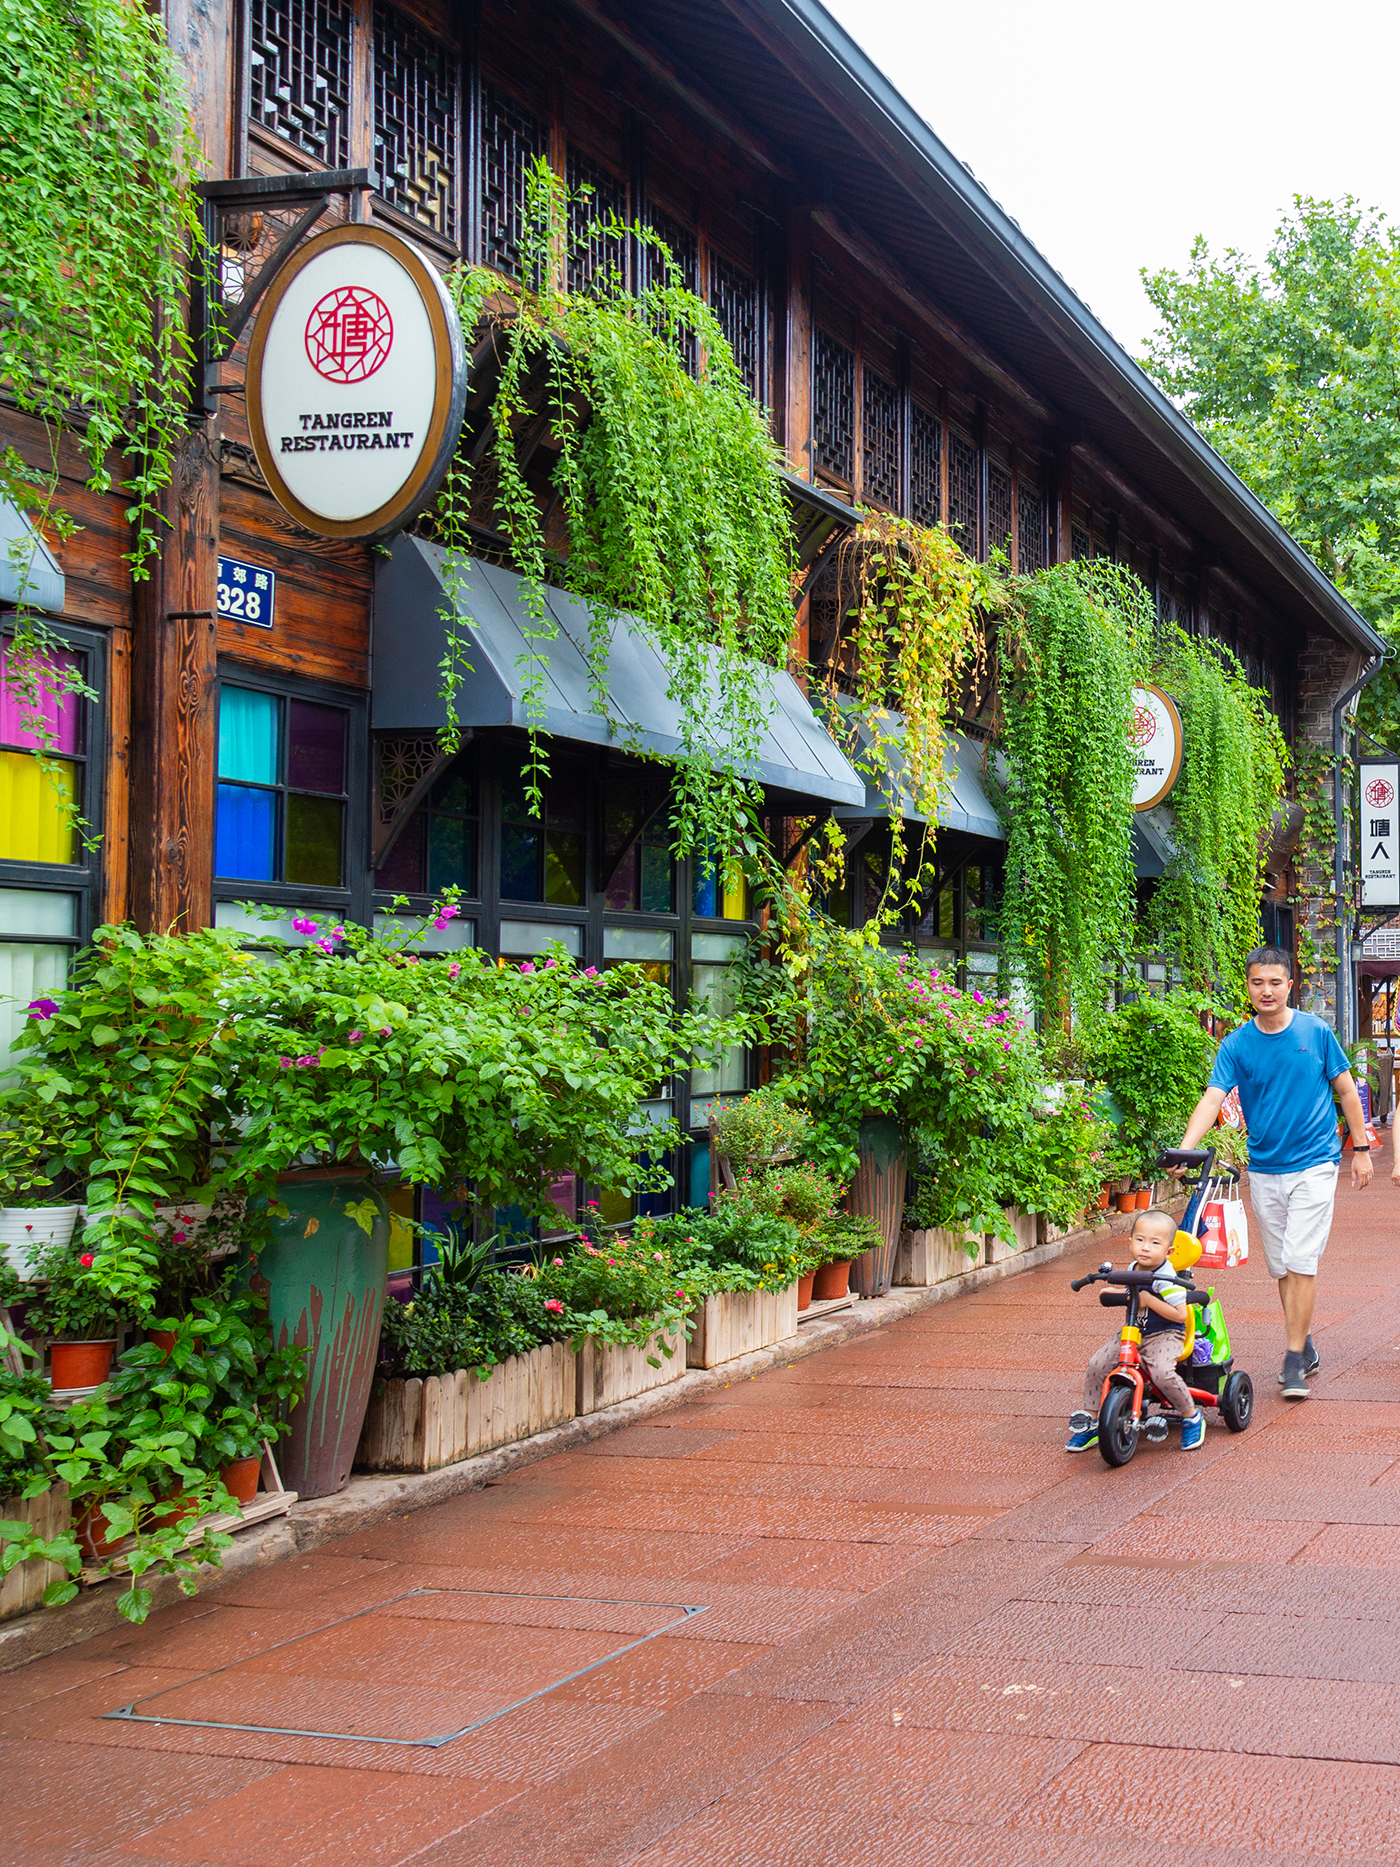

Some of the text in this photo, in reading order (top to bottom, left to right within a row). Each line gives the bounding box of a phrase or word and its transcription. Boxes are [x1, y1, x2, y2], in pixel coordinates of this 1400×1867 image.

[299, 411, 393, 430] TANGREN
[280, 432, 414, 452] RESTAURANT
[1370, 819, 1390, 859] 塘人
